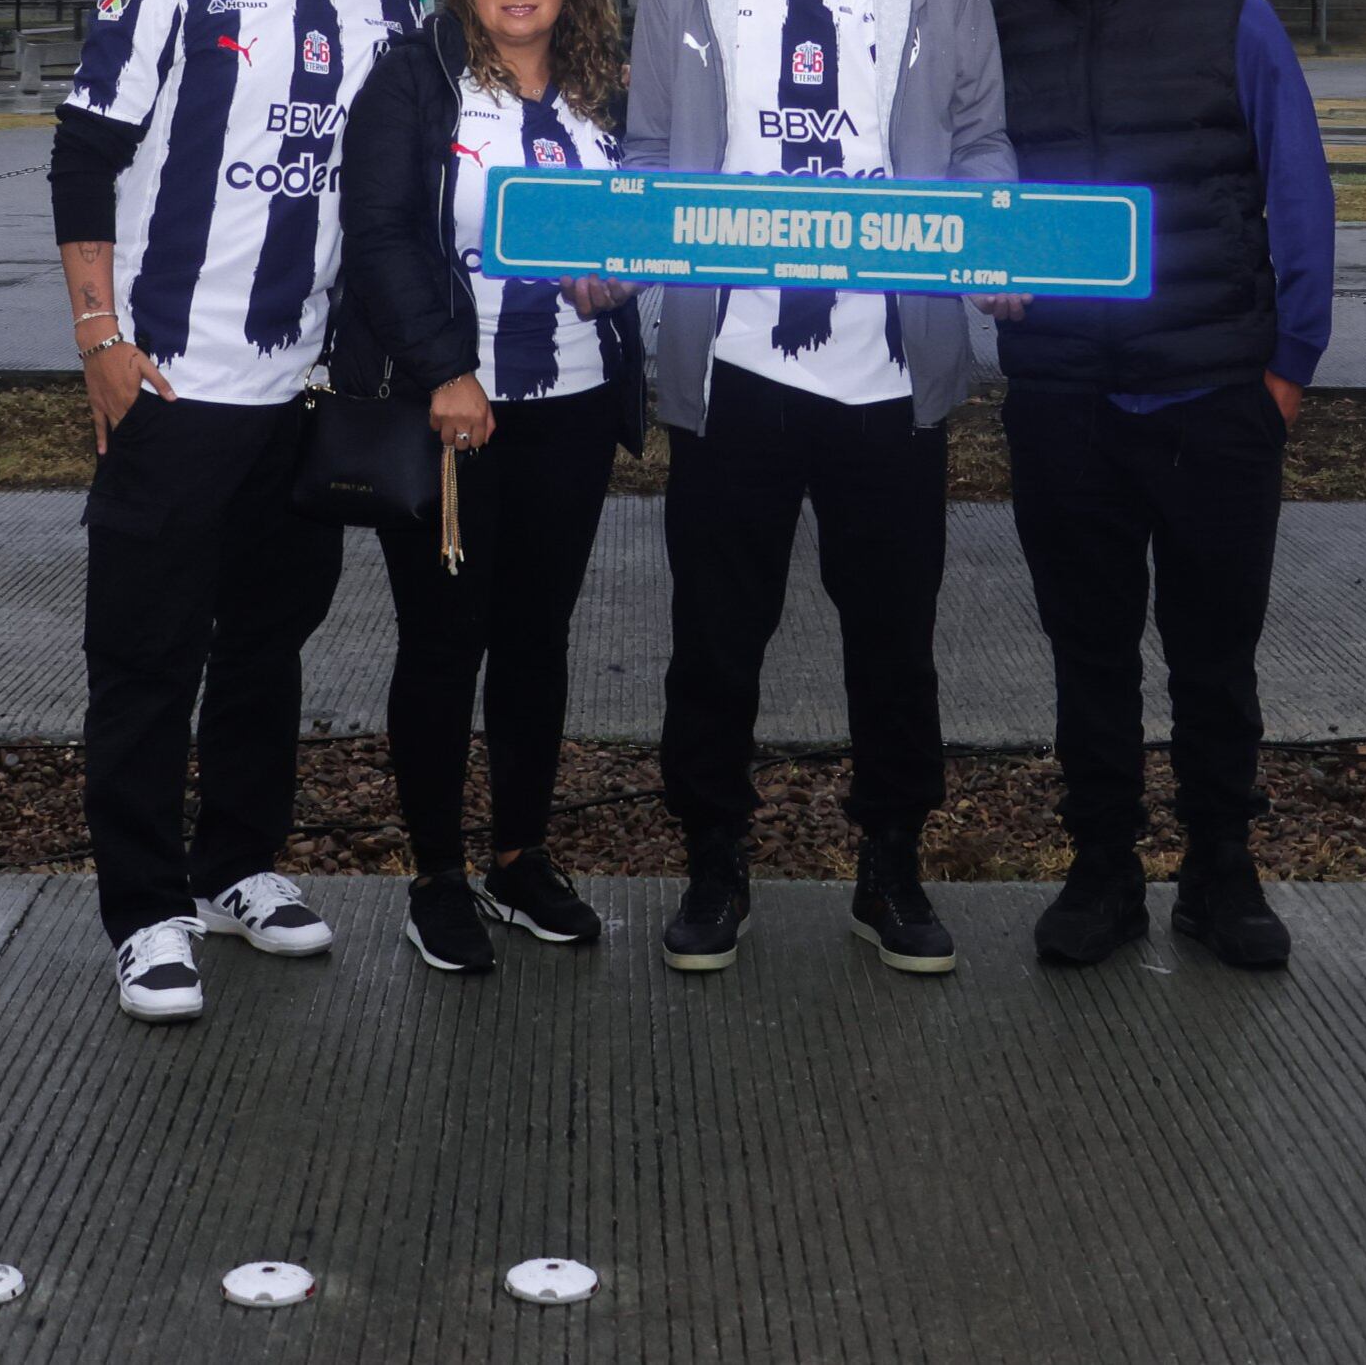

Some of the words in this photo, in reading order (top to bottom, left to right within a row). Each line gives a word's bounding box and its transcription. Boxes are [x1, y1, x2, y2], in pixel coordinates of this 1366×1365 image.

[304, 39, 330, 63] 26
[305, 63, 328, 73] ETERNO
[794, 52, 823, 73] 26
[794, 74, 822, 83] ETERNO
[266, 103, 346, 135] BBVA
[759, 110, 859, 140] BBVA
[610, 177, 645, 194] CALLE
[673, 206, 853, 250] HUMBERTO
[860, 213, 964, 253] SUAZO
[629, 258, 644, 273] LA
